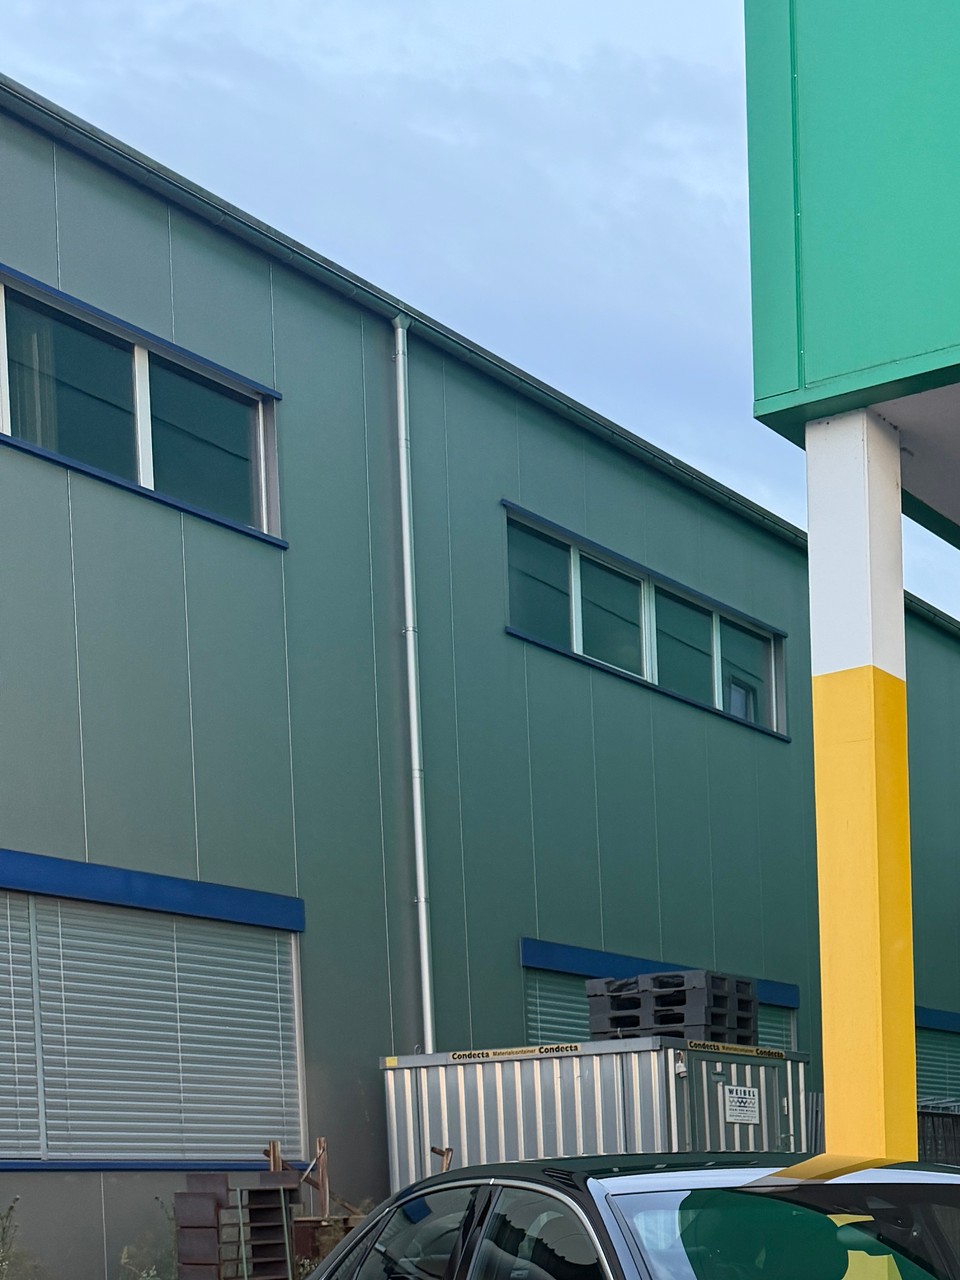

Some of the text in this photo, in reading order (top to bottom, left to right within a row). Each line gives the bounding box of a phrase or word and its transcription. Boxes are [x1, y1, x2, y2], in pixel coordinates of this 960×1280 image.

[452, 1051, 490, 1060] Condecta
[538, 1044, 579, 1054] Condecta
[689, 1041, 720, 1051] Condecta
[755, 1048, 784, 1059] Condecta
[728, 1088, 756, 1097] WEIBEL
